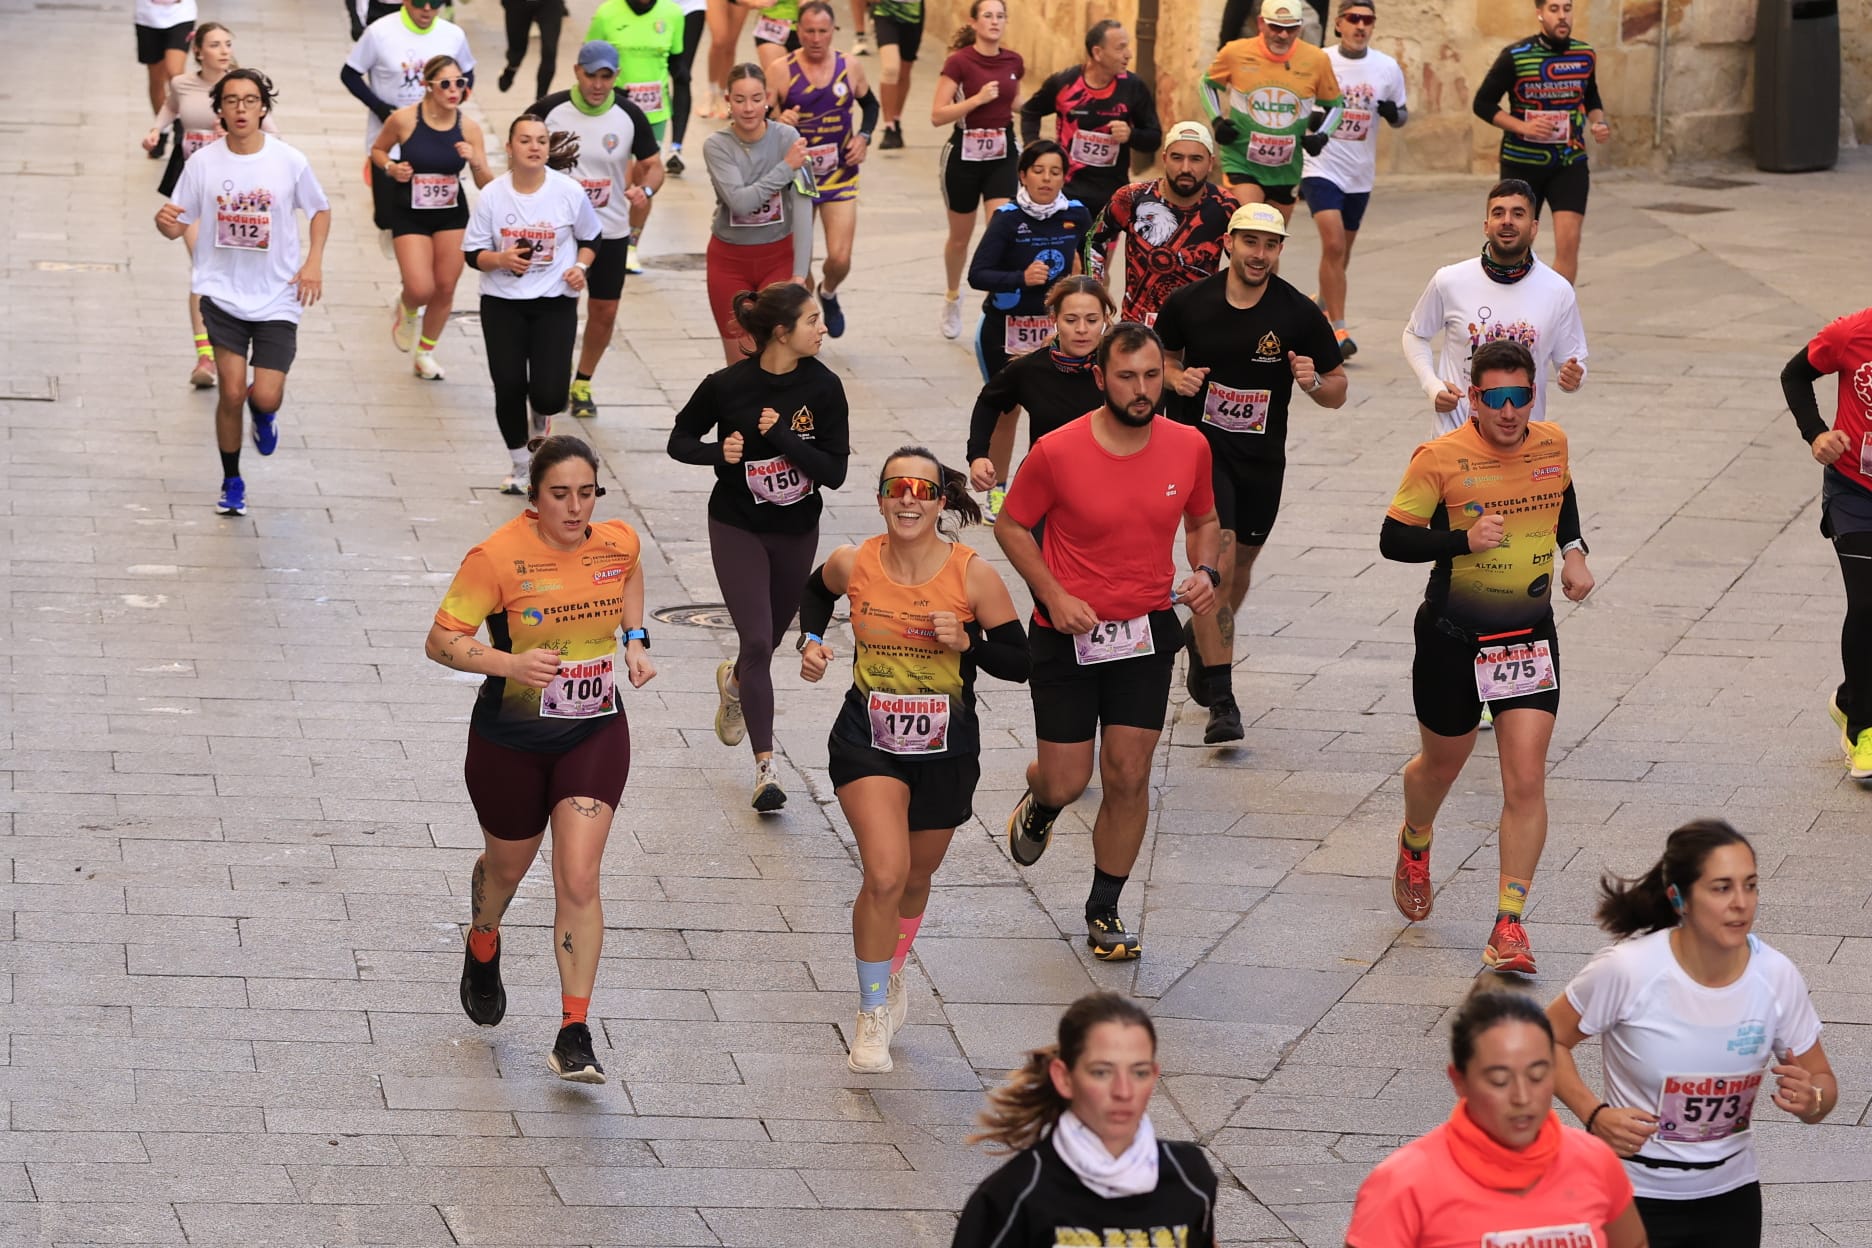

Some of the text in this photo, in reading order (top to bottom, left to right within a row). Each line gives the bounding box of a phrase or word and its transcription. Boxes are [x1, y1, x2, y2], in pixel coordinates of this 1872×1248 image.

[1338, 120, 1362, 132] 276
[977, 139, 994, 151] 70
[1082, 142, 1110, 157] 525
[1258, 144, 1285, 157] 641
[423, 185, 450, 198] 395
[229, 223, 259, 238] 112
[1018, 328, 1049, 342] 510
[1217, 400, 1254, 419] 448
[763, 468, 800, 492] 150
[1485, 497, 1528, 509] ESCUELA
[543, 602, 590, 615] ESCUELA
[1090, 620, 1132, 645] 491
[868, 643, 902, 651] ESCUELA
[876, 650, 932, 660] SALMANTINA
[560, 659, 613, 679] edunia
[1493, 659, 1537, 683] 475
[562, 677, 603, 700] 100
[870, 694, 947, 714] bedunia
[885, 714, 931, 736] 170
[1664, 1074, 1762, 1096] bedunia
[1684, 1095, 1741, 1122] 573
